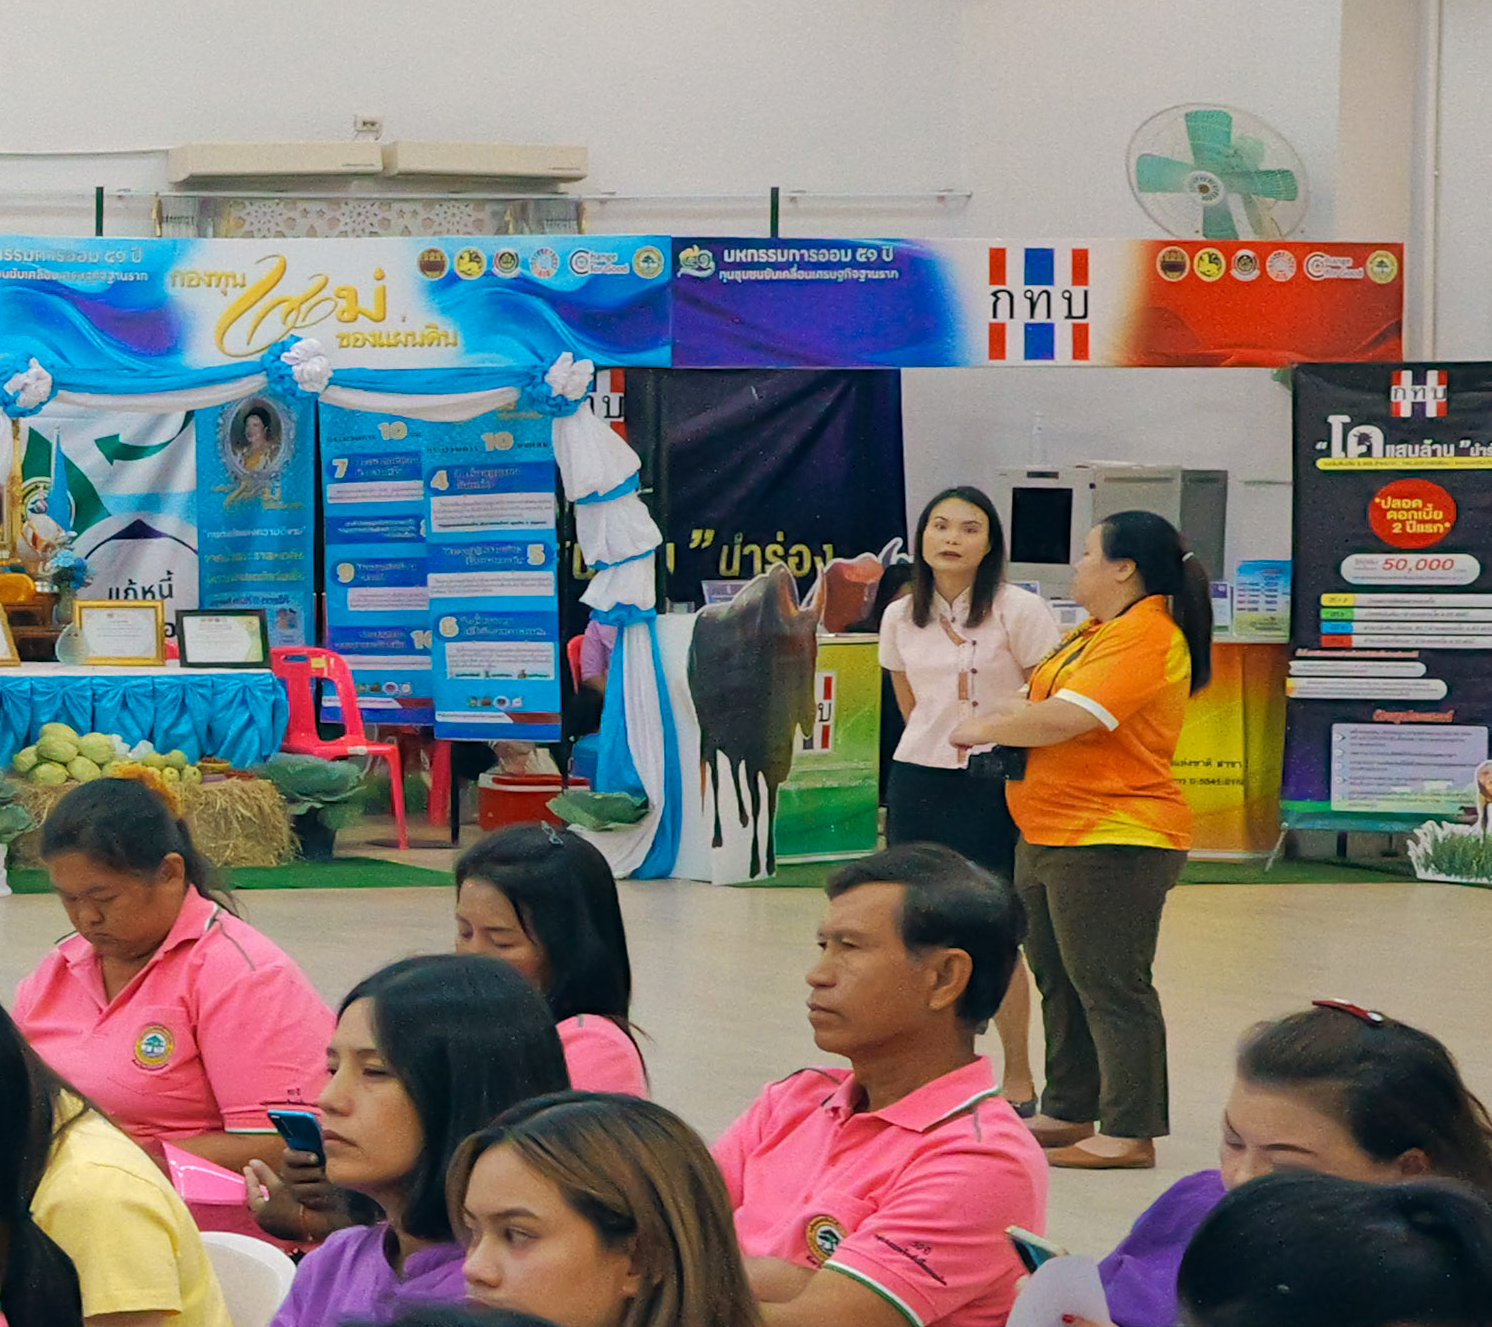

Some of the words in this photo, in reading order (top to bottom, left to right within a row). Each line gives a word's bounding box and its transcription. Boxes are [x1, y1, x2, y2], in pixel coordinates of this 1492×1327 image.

[378, 421, 408, 441] 10
[481, 431, 514, 451] 10
[331, 458, 349, 478] 7
[430, 470, 449, 491] 4
[1392, 523, 1402, 534] 2
[526, 544, 545, 565] 5
[1382, 558, 1455, 573] 50,000
